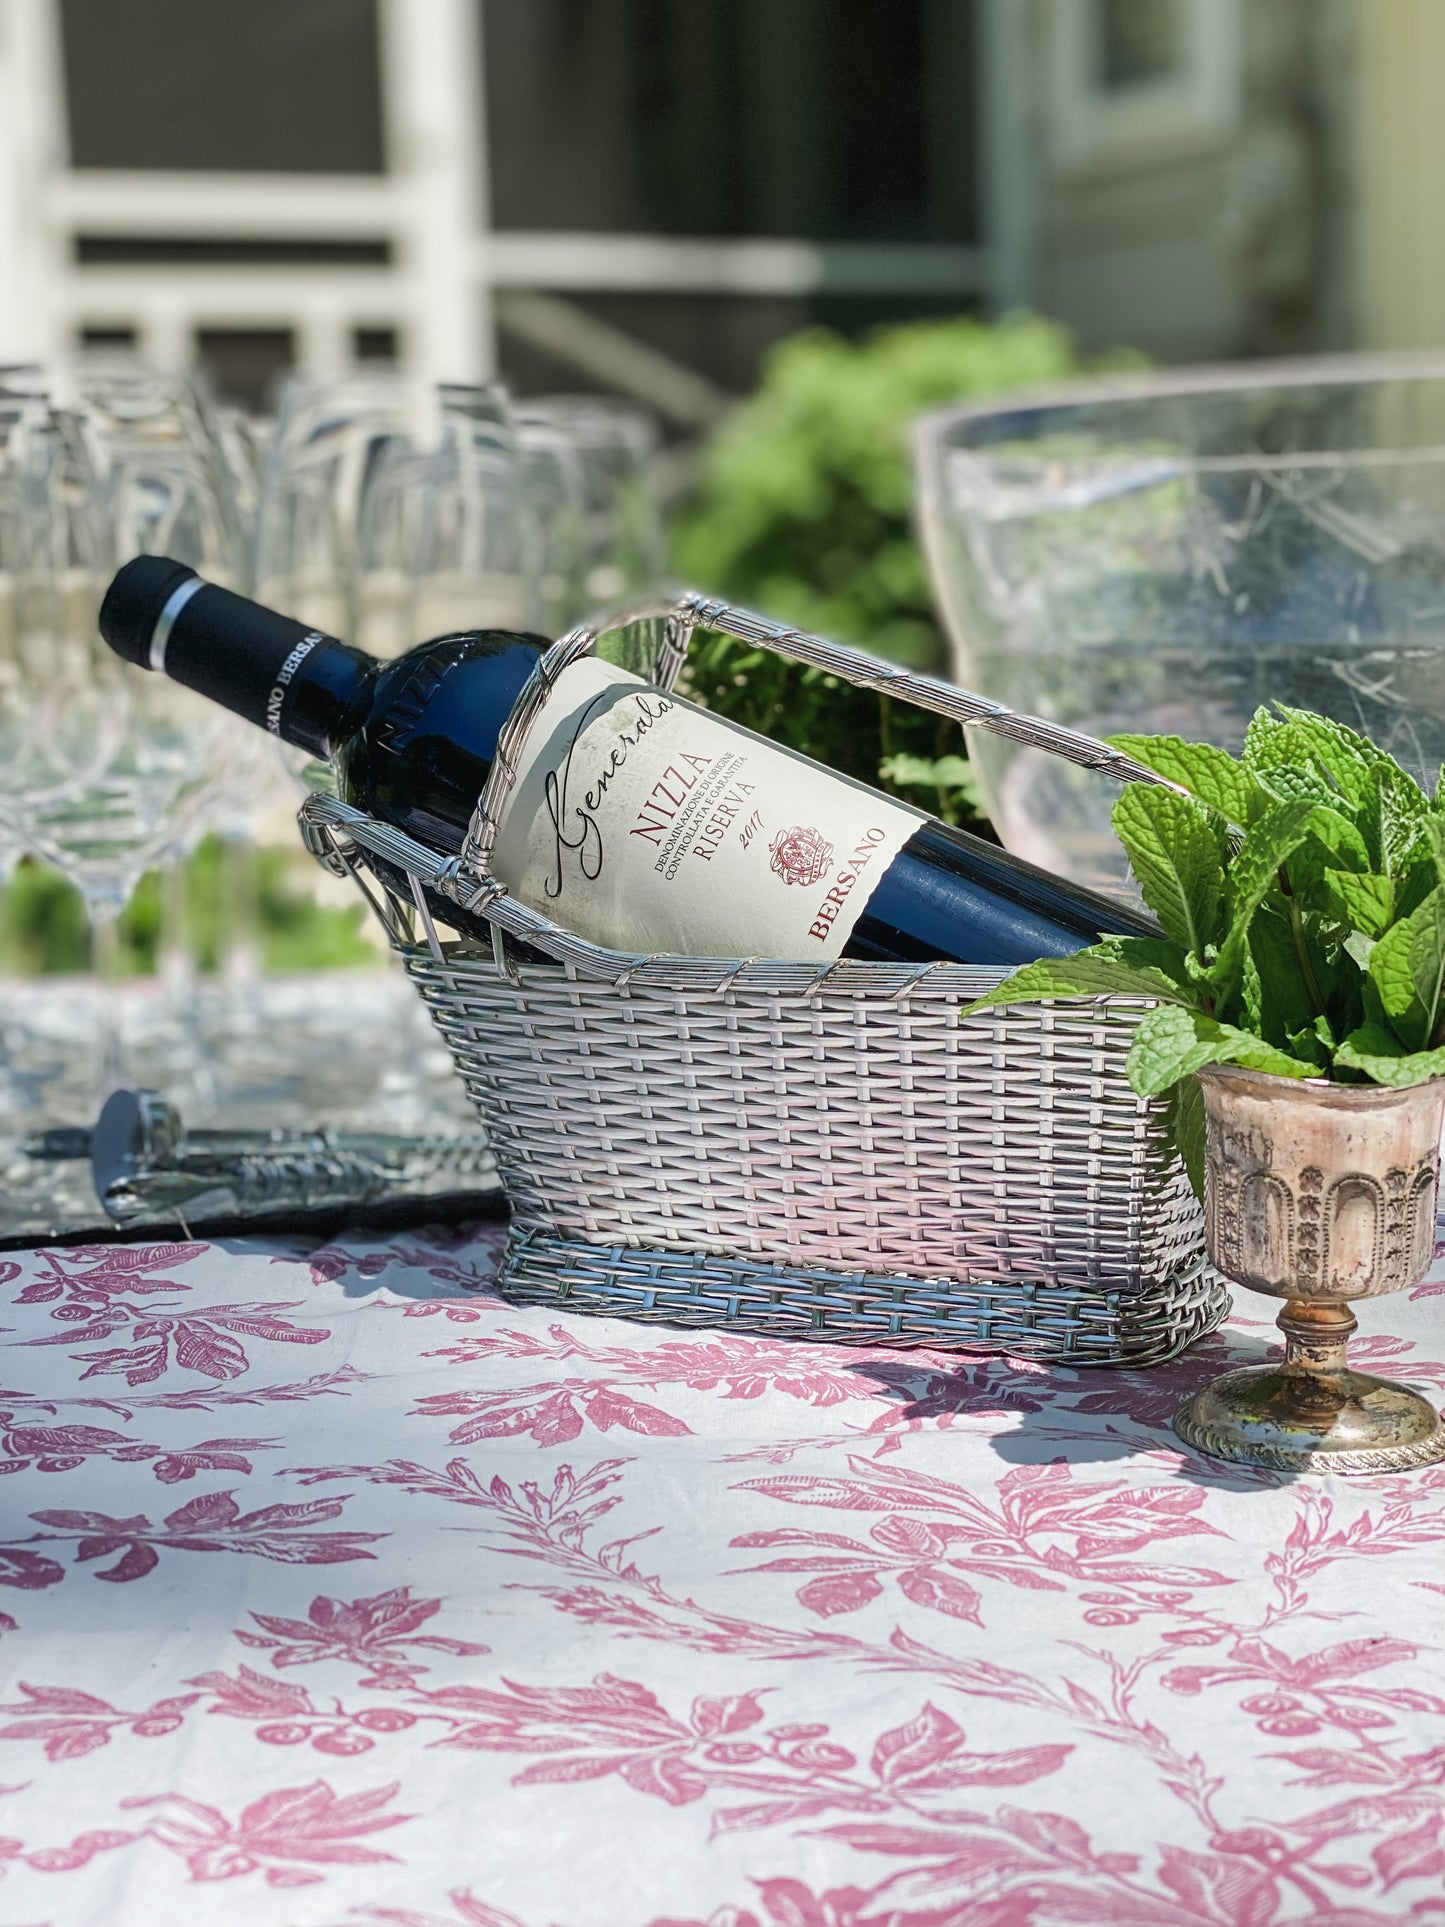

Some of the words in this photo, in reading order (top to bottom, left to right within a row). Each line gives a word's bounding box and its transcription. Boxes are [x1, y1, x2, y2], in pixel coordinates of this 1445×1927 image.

[266, 686, 285, 736] SANO
[544, 693, 674, 898] Generala
[629, 753, 713, 847] NIZZA
[654, 789, 705, 873] DENOMINAZIONE
[700, 779, 711, 790] DI
[707, 752, 735, 780] ORIGINE
[665, 806, 710, 881] CONTROLLATA
[704, 797, 715, 806] E
[710, 756, 748, 798] GARANTITA
[692, 781, 756, 861] RISERVA
[739, 809, 765, 850] 2017
[808, 828, 886, 943] BERSANO
